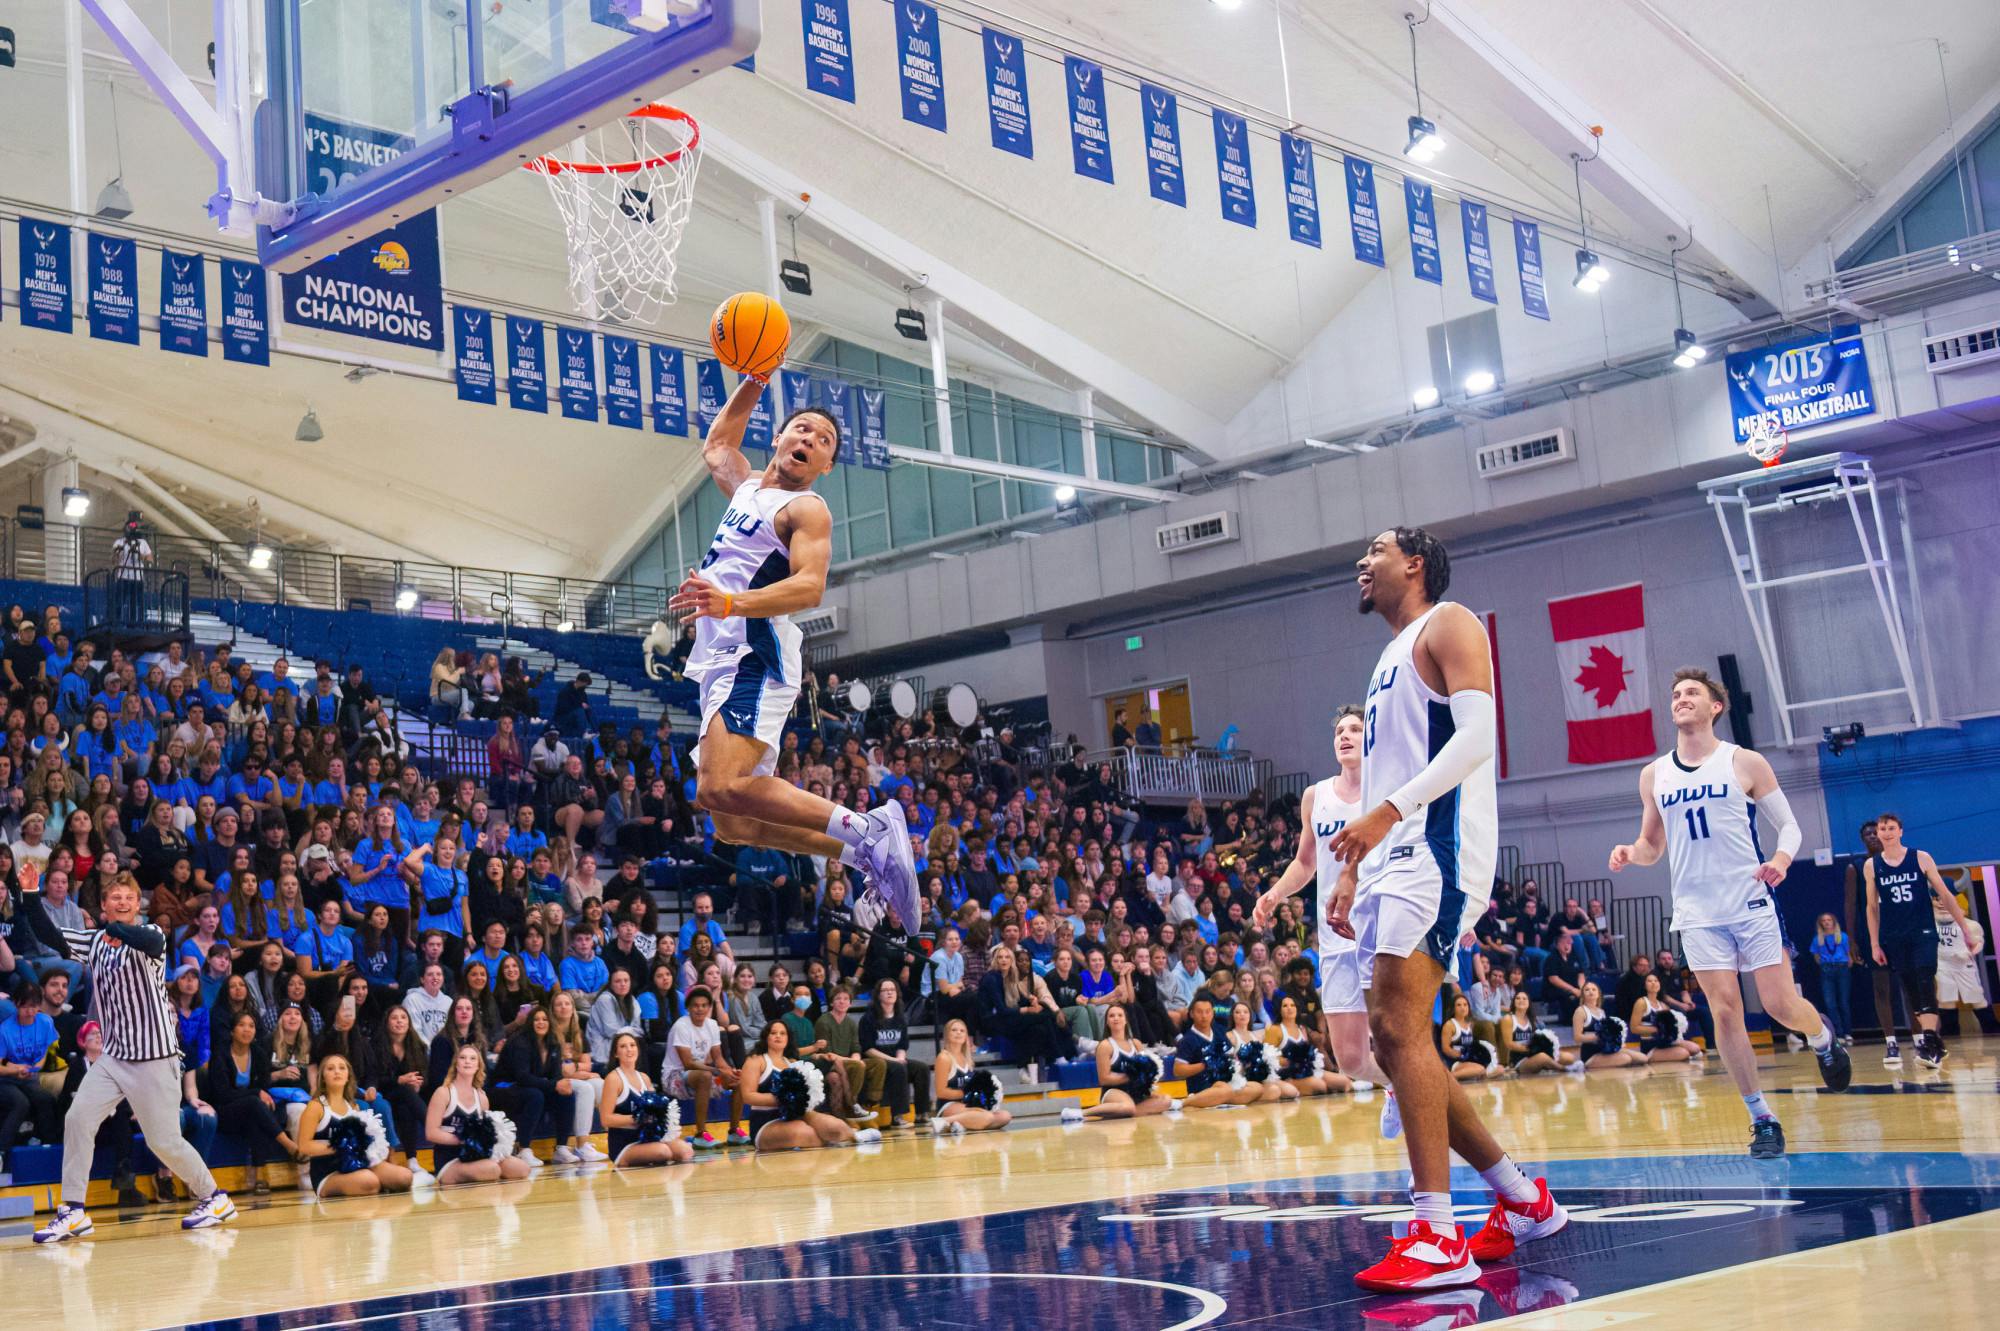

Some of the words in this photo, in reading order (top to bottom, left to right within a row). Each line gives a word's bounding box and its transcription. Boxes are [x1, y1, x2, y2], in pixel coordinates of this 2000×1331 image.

[815, 3, 837, 24] 1996
[811, 21, 843, 42] WOMEN'S
[808, 33, 849, 57] BASKETBALL
[908, 36, 931, 57] 2000
[905, 53, 936, 74] WOMEN'S
[903, 65, 941, 88] BASKETBALL
[995, 66, 1016, 87] 2000
[993, 83, 1022, 103] WOMEN'S
[991, 94, 1026, 116] BASKETBALL
[1077, 95, 1097, 114] 2002
[1075, 111, 1102, 129] WOMEN'S
[1073, 122, 1107, 142] BASKETBALL
[1151, 136, 1176, 154] WOMEN'S
[1149, 147, 1180, 167] BASKETBALL
[1222, 160, 1246, 177] WOMEN'S
[1221, 171, 1250, 189] BASKETBALL
[1290, 182, 1312, 199] WOMEN'S
[1288, 192, 1315, 211] BASKETBALL
[1353, 213, 1379, 230] BASKETBALL
[35, 252, 56, 269] 1979
[35, 269, 57, 282] MEN'S
[100, 266, 123, 282] 1988
[25, 278, 67, 295] BASKETBALL
[102, 283, 123, 295] MEN'S
[172, 282, 195, 296] 1994
[305, 274, 422, 316] NATIONAL
[93, 290, 134, 307] BASKETBALL
[173, 297, 195, 307] MEN'S
[234, 292, 254, 306] 2001
[165, 305, 203, 319] BASKETBALL
[234, 307, 254, 319] MEN'S
[295, 296, 432, 341] CHAMPIONS
[226, 315, 264, 330] BASKETBALL
[465, 335, 483, 349] 2001
[466, 350, 484, 361] MEN'S
[516, 345, 535, 359] 2002
[460, 358, 492, 371] BASKETBALL
[518, 360, 535, 370] MEN'S
[1765, 347, 1824, 387] 2013
[512, 367, 543, 381] BASKETBALL
[569, 370, 585, 380] MEN'S
[661, 372, 676, 386] 2012
[562, 377, 593, 390] BASKETBALL
[609, 385, 638, 398] BASKETBALL
[615, 378, 631, 388] MEN'S
[661, 386, 677, 396] MEN'S
[655, 393, 683, 406] BASKETBALL
[1764, 391, 1799, 406] FINAL
[1801, 383, 1836, 398] FOUR
[1738, 410, 1780, 435] MEN'S
[1782, 390, 1869, 426] BASKETBALL
[1661, 784, 1728, 809] WWU
[1685, 806, 1710, 840] 11
[1879, 872, 1918, 886] WWU
[1890, 885, 1913, 903] 35
